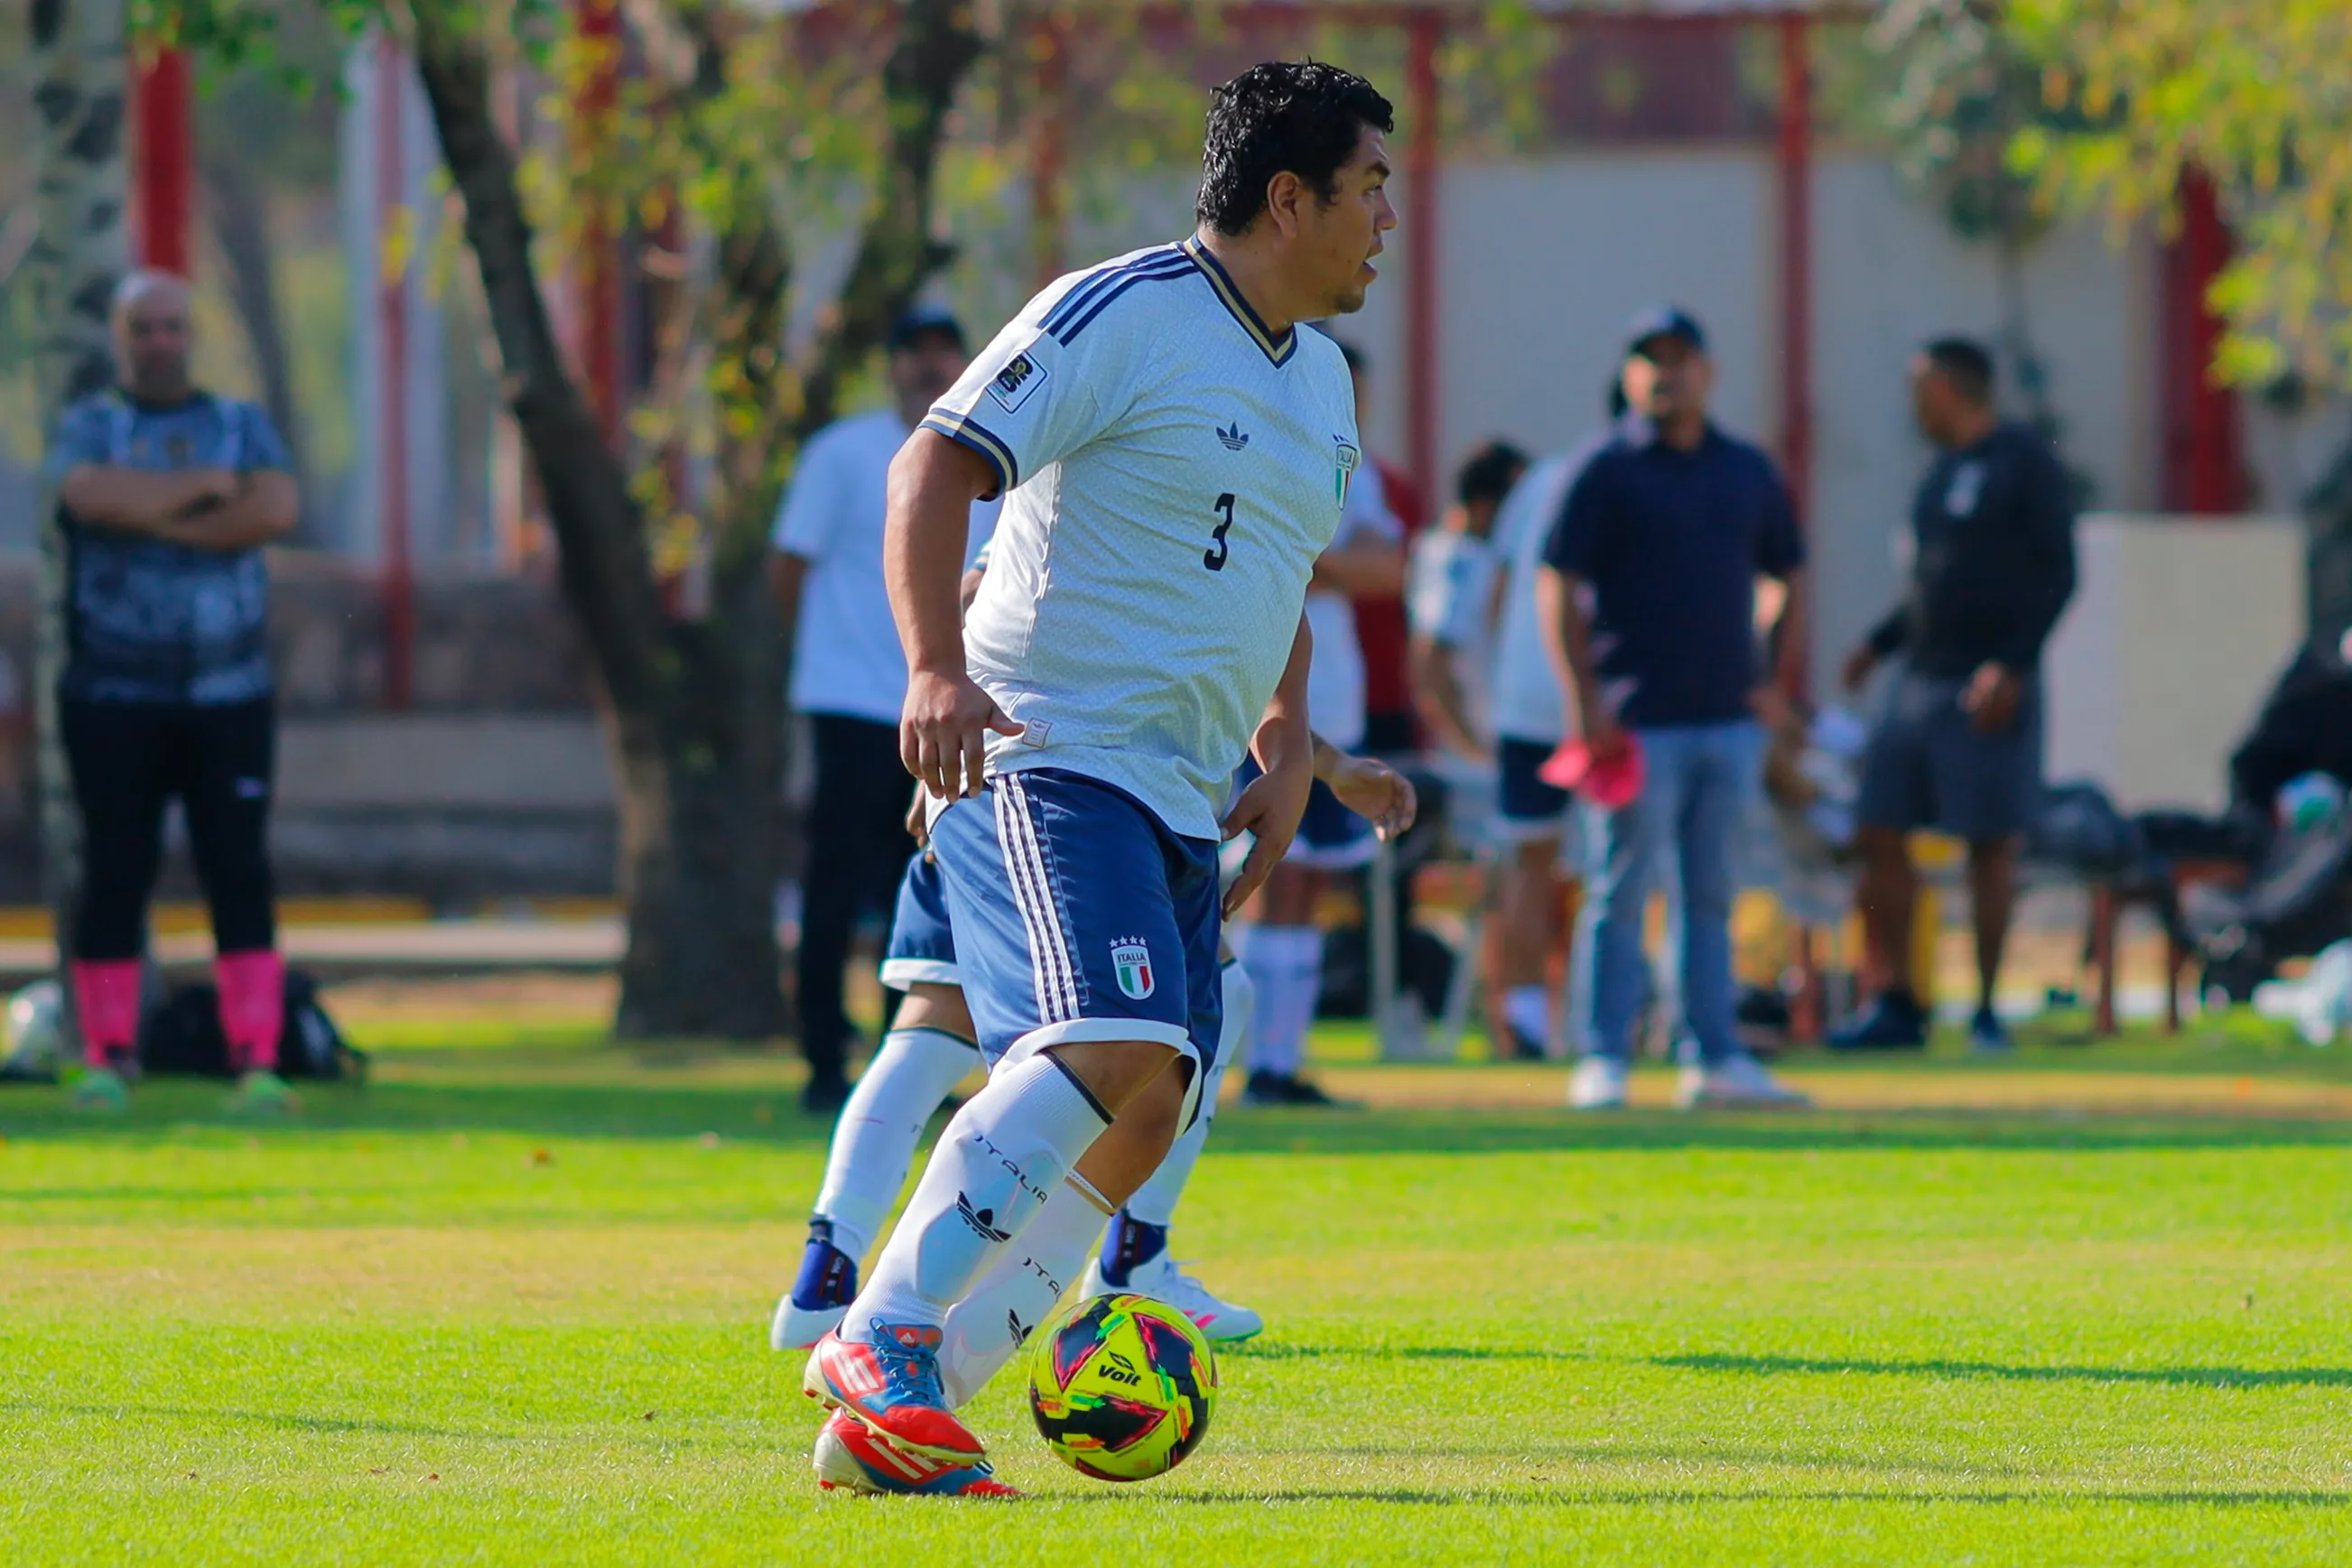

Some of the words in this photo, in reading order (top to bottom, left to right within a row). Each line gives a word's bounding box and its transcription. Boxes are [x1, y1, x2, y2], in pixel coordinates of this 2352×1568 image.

[1204, 493, 1235, 571] 3
[1117, 952, 1147, 963] ITALIA
[974, 1135, 1048, 1204] ITALIA
